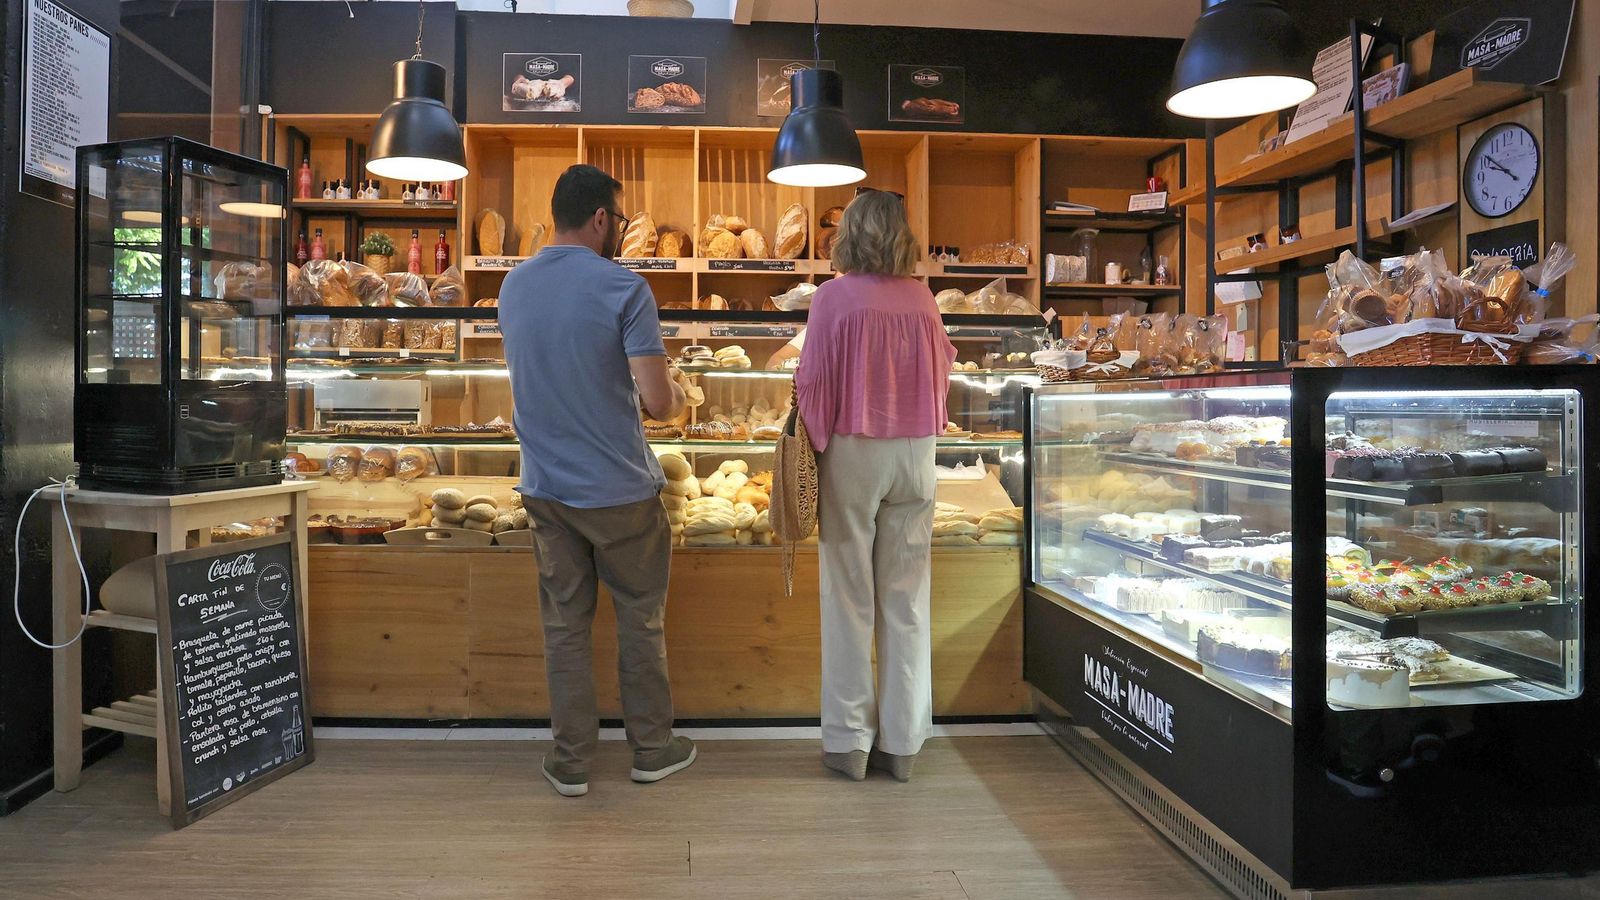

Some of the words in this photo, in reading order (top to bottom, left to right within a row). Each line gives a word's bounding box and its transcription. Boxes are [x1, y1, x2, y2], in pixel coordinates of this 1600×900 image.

[34, 0, 68, 25] NUESTROS
[70, 16, 89, 38] PANES
[1467, 28, 1522, 61] MASA-MADRE
[1491, 138, 1499, 154] 11
[1503, 130, 1513, 147] 12
[1477, 171, 1485, 185] 9
[1481, 187, 1489, 201] 8
[1490, 195, 1497, 210] 7
[1504, 195, 1512, 210] 6
[208, 552, 257, 583] Coca-Cola
[177, 593, 208, 607] CARTA
[235, 584, 245, 593] DE
[281, 582, 287, 591] €
[200, 601, 236, 619] SEMANA
[222, 626, 230, 636] de
[234, 620, 254, 632] carne
[257, 610, 284, 627] picada
[182, 650, 192, 661] de
[224, 629, 257, 649] gratinado
[271, 650, 291, 664] queso
[183, 661, 234, 685] Hamburguesa
[236, 653, 253, 667] pollo
[254, 645, 275, 657] crispy
[279, 640, 290, 648] con
[184, 663, 190, 674] y
[194, 655, 214, 667] salsa
[187, 702, 213, 718] Rollito
[250, 684, 263, 693] con
[190, 698, 195, 708] y
[191, 716, 205, 728] col
[208, 714, 213, 725] y
[216, 704, 237, 717] cerdo
[239, 693, 261, 707] asado
[1084, 653, 1175, 744] MASA-MADRE
[190, 724, 221, 742] Pantera
[223, 716, 240, 728] rosa
[242, 710, 251, 719] de
[289, 691, 299, 699] con
[191, 732, 226, 752] ensalada
[228, 727, 238, 737] de
[260, 706, 284, 720] cebolla
[194, 745, 220, 765] crunch
[221, 743, 228, 754] y
[229, 734, 250, 748] salsa
